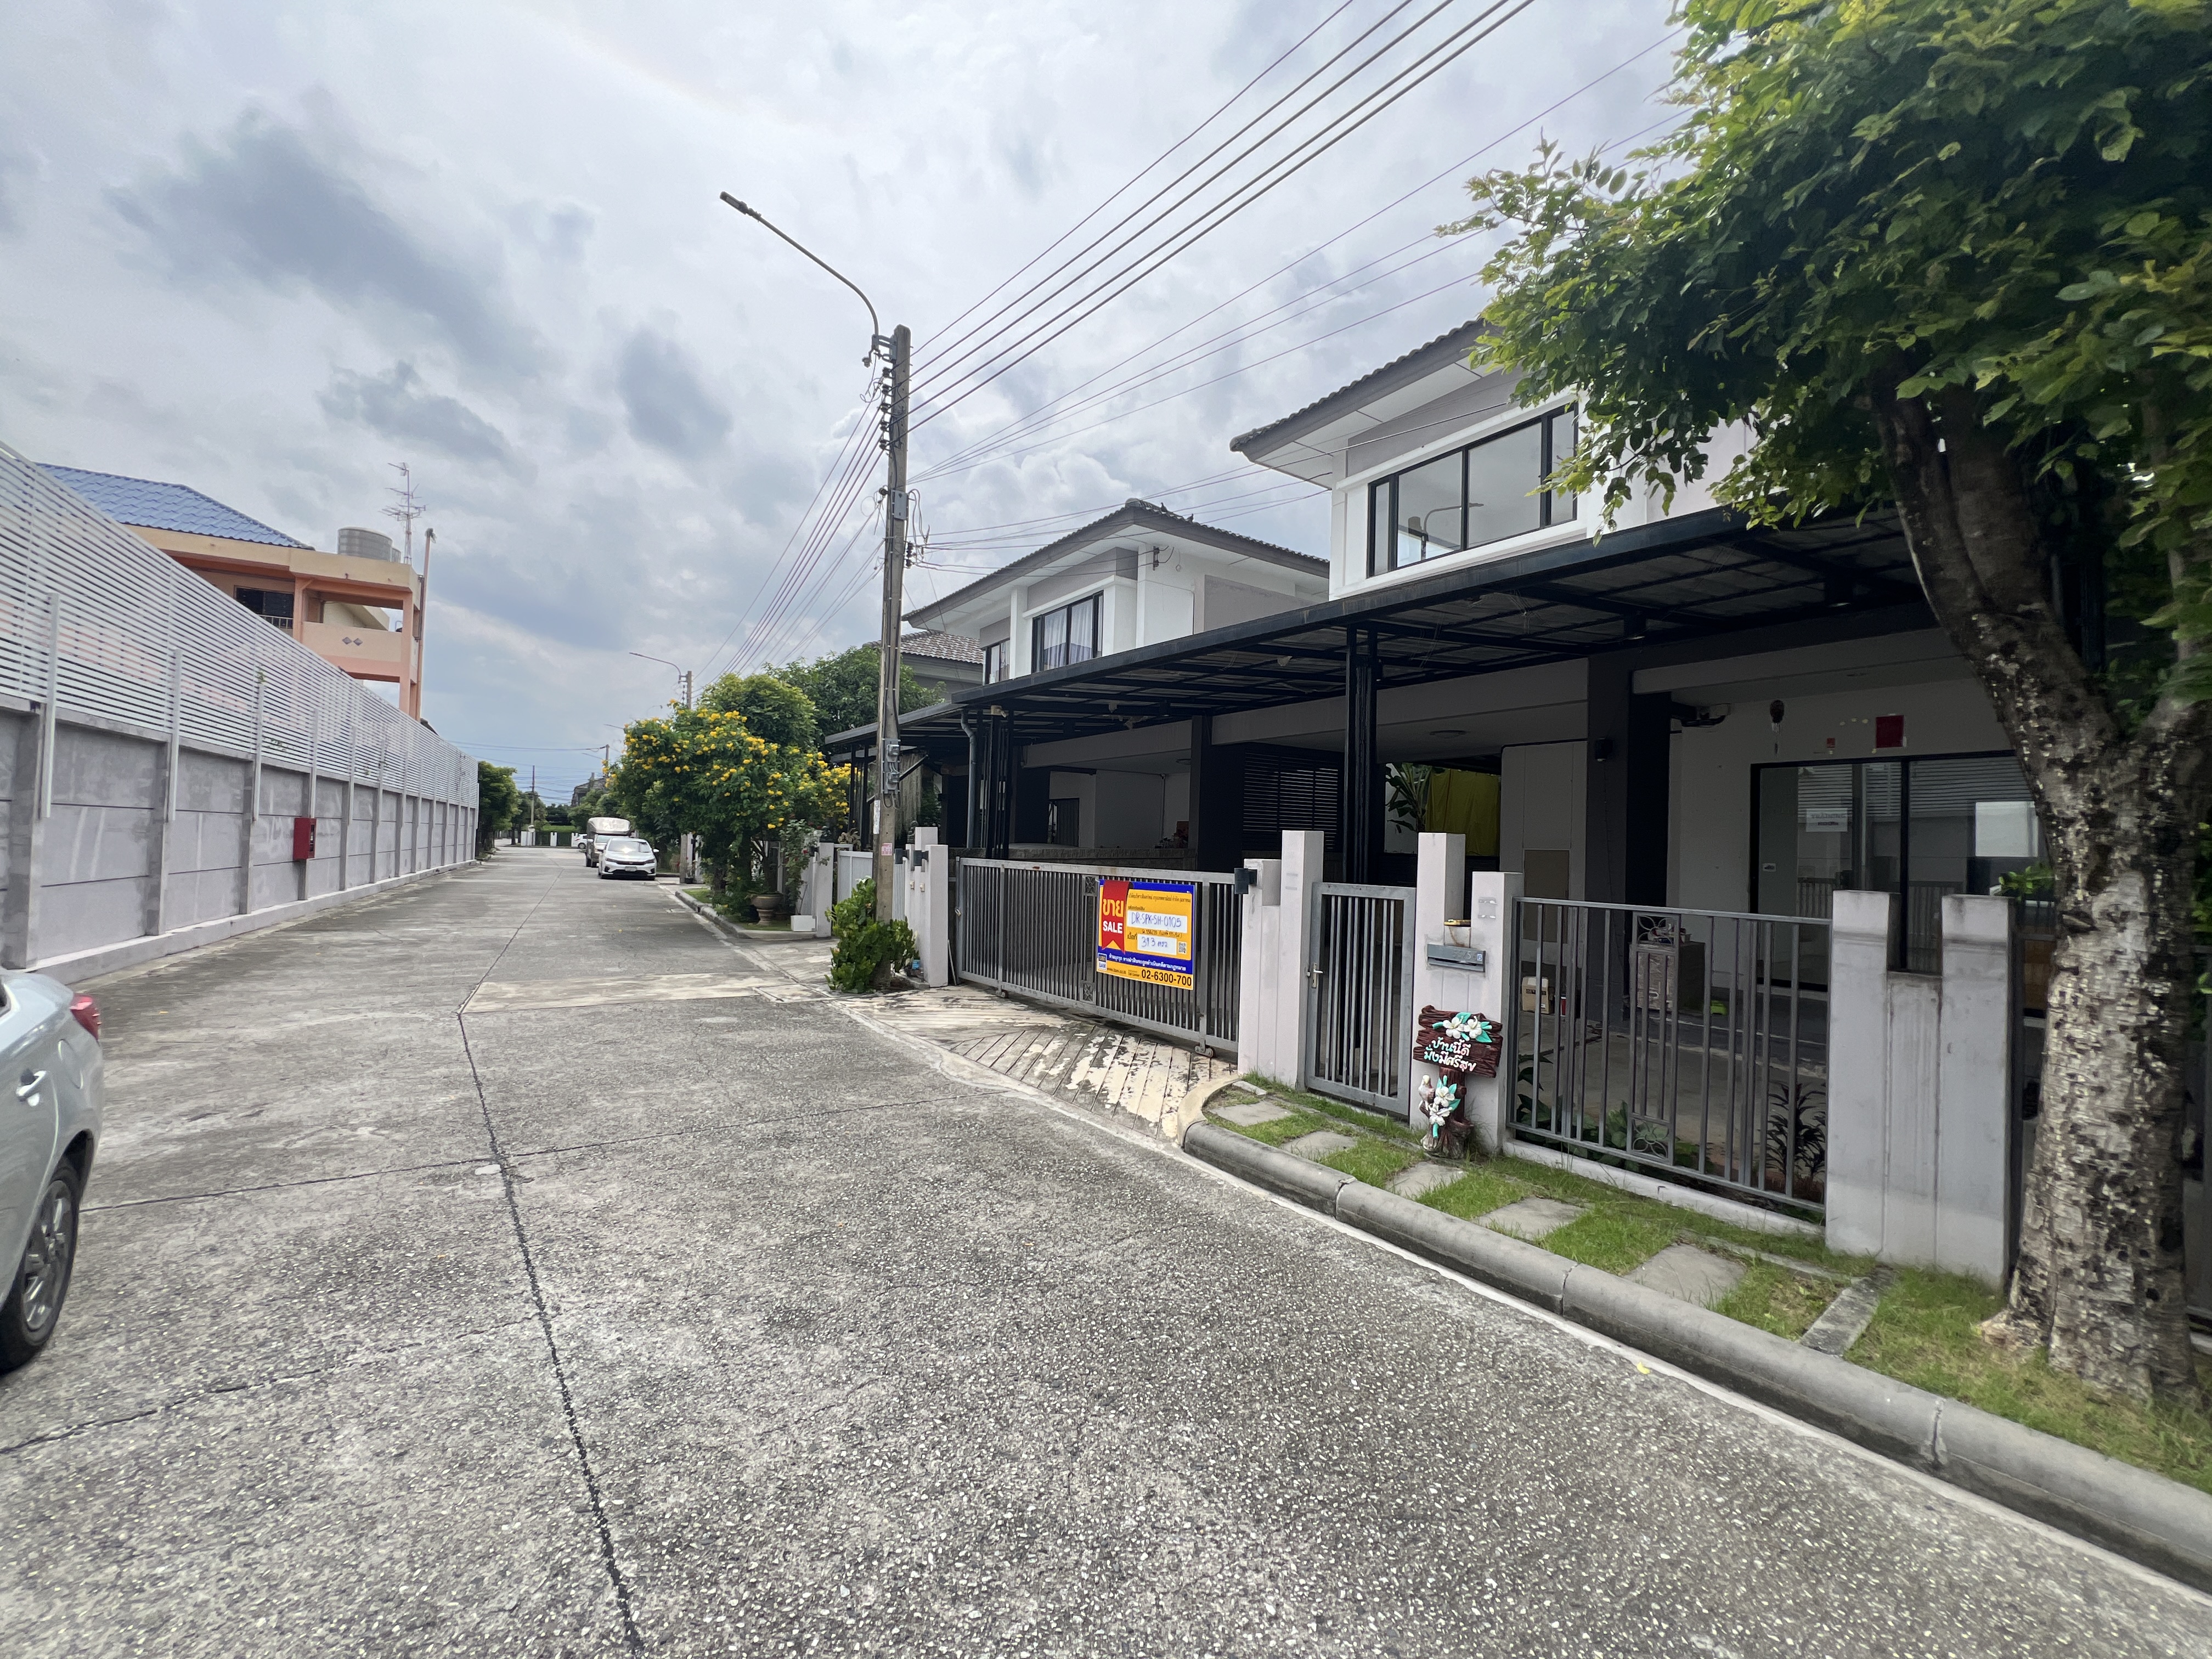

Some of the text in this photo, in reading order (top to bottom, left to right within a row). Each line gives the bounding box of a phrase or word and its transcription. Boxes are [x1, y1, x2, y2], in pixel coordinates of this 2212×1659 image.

[1103, 898, 1124, 917] ขาย
[1103, 921, 1123, 933] SALE
[1131, 912, 1182, 928] DR-SPK-SH-0105
[1141, 969, 1192, 986] 02-6300-700
[1431, 1036, 1471, 1056] บ้านนี้ดี
[1424, 1044, 1477, 1072] มั่งมีศรีสุข
